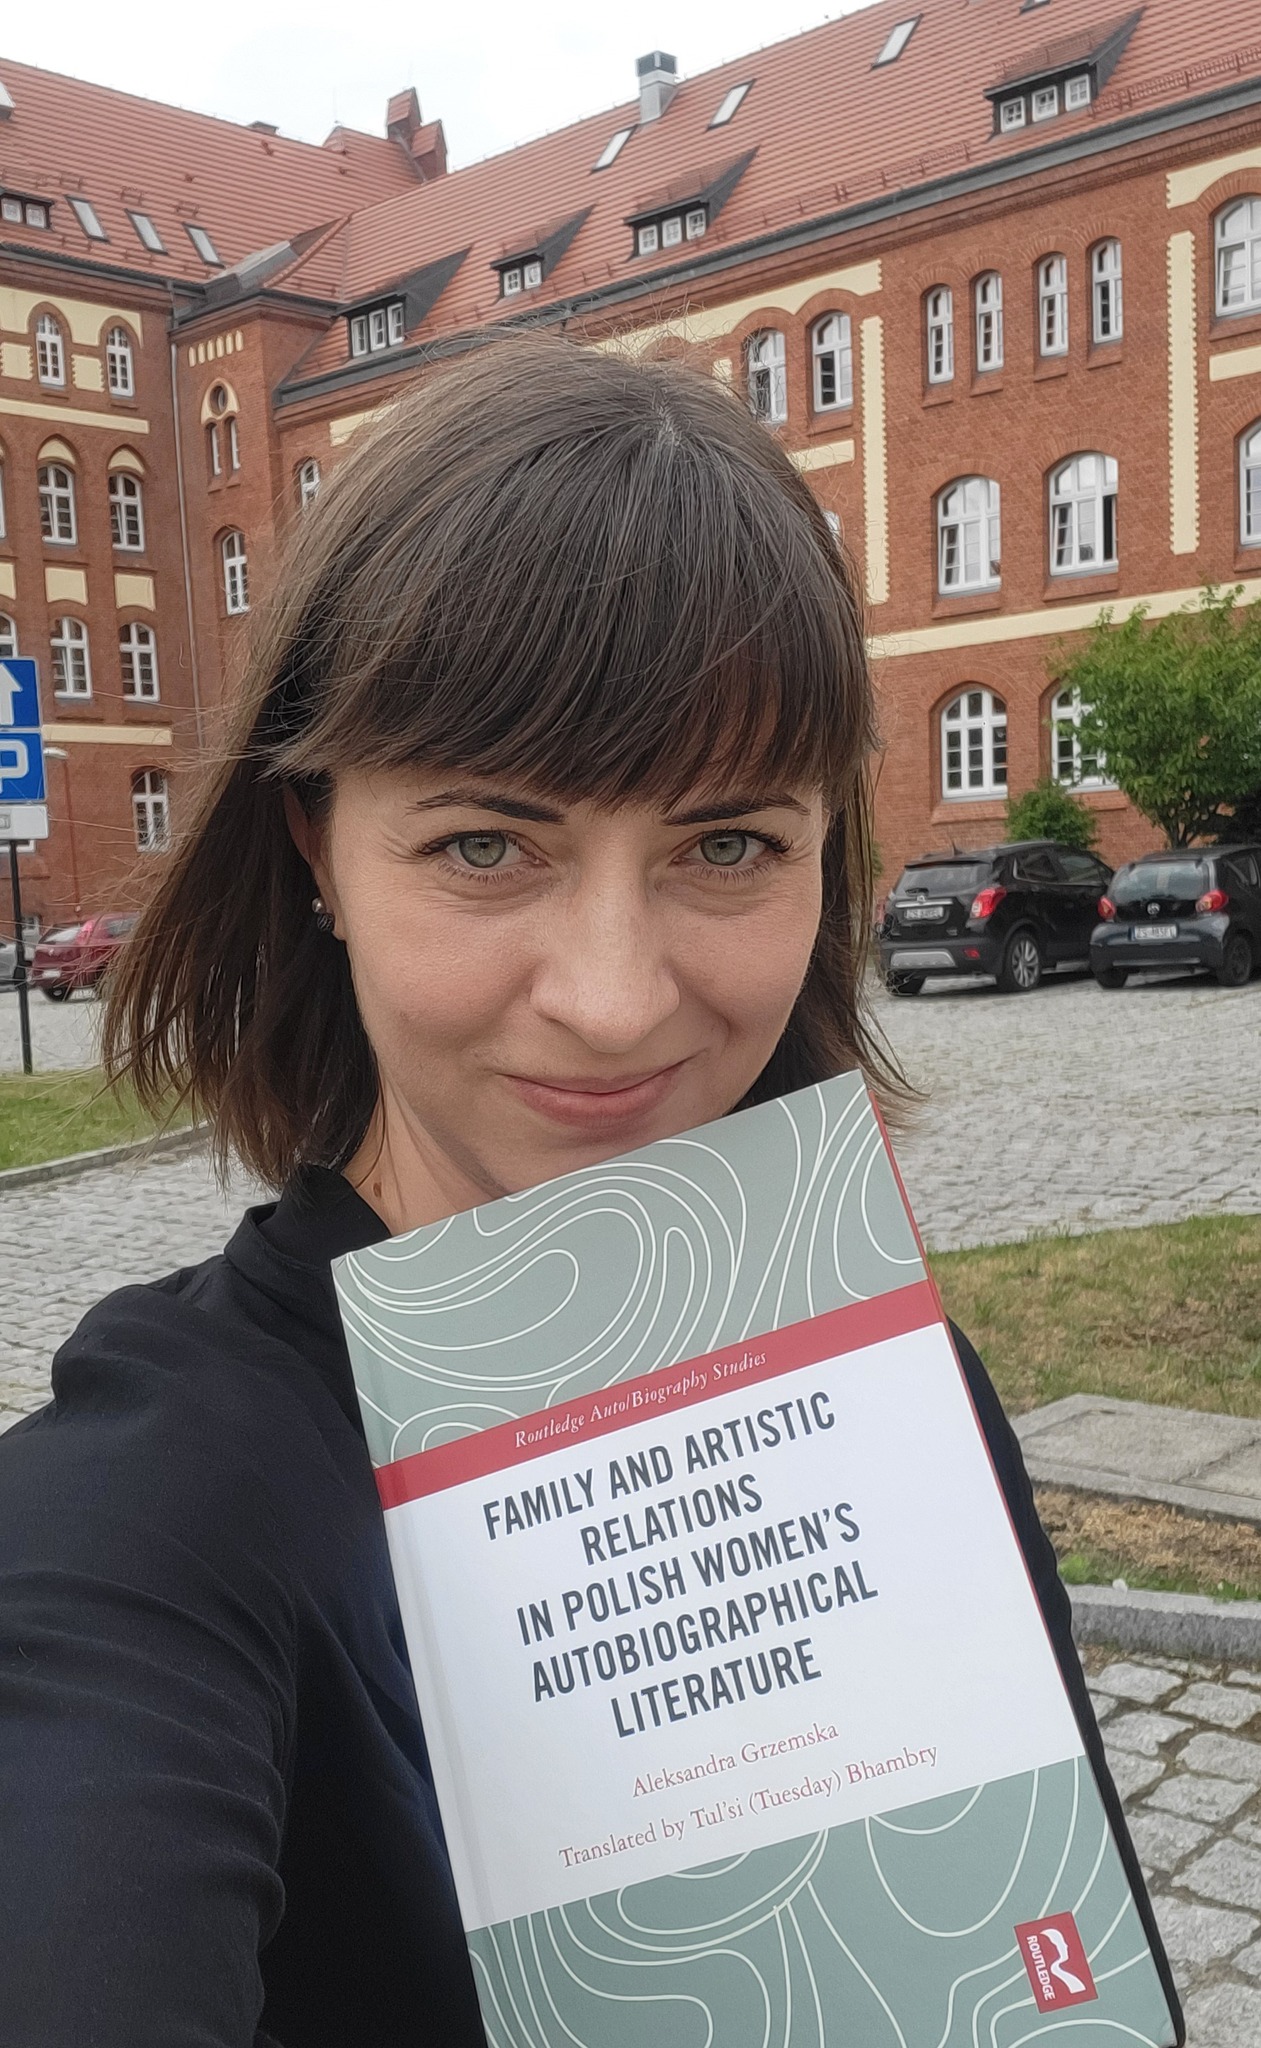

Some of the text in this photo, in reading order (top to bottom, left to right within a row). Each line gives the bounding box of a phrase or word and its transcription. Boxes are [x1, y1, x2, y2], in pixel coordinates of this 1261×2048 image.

[0, 739, 28, 795] P
[514, 1350, 767, 1447] Routledge Auto/Biography Studies
[483, 1392, 836, 1540] FAMILY AND ARTISTIC
[580, 1474, 762, 1565] RELATIONS
[517, 1503, 861, 1646] IN POLISH WOMEN'S
[534, 1560, 878, 1702] AUTOBIOGRAPHICAL
[610, 1638, 822, 1738] LITERATURE
[558, 1745, 939, 1868] Translated by Tul'si (Tuesday) Bhambry
[632, 1722, 840, 1797] Aleksandra Grzemska
[1026, 1935, 1056, 2001] ROUTLEDGE
